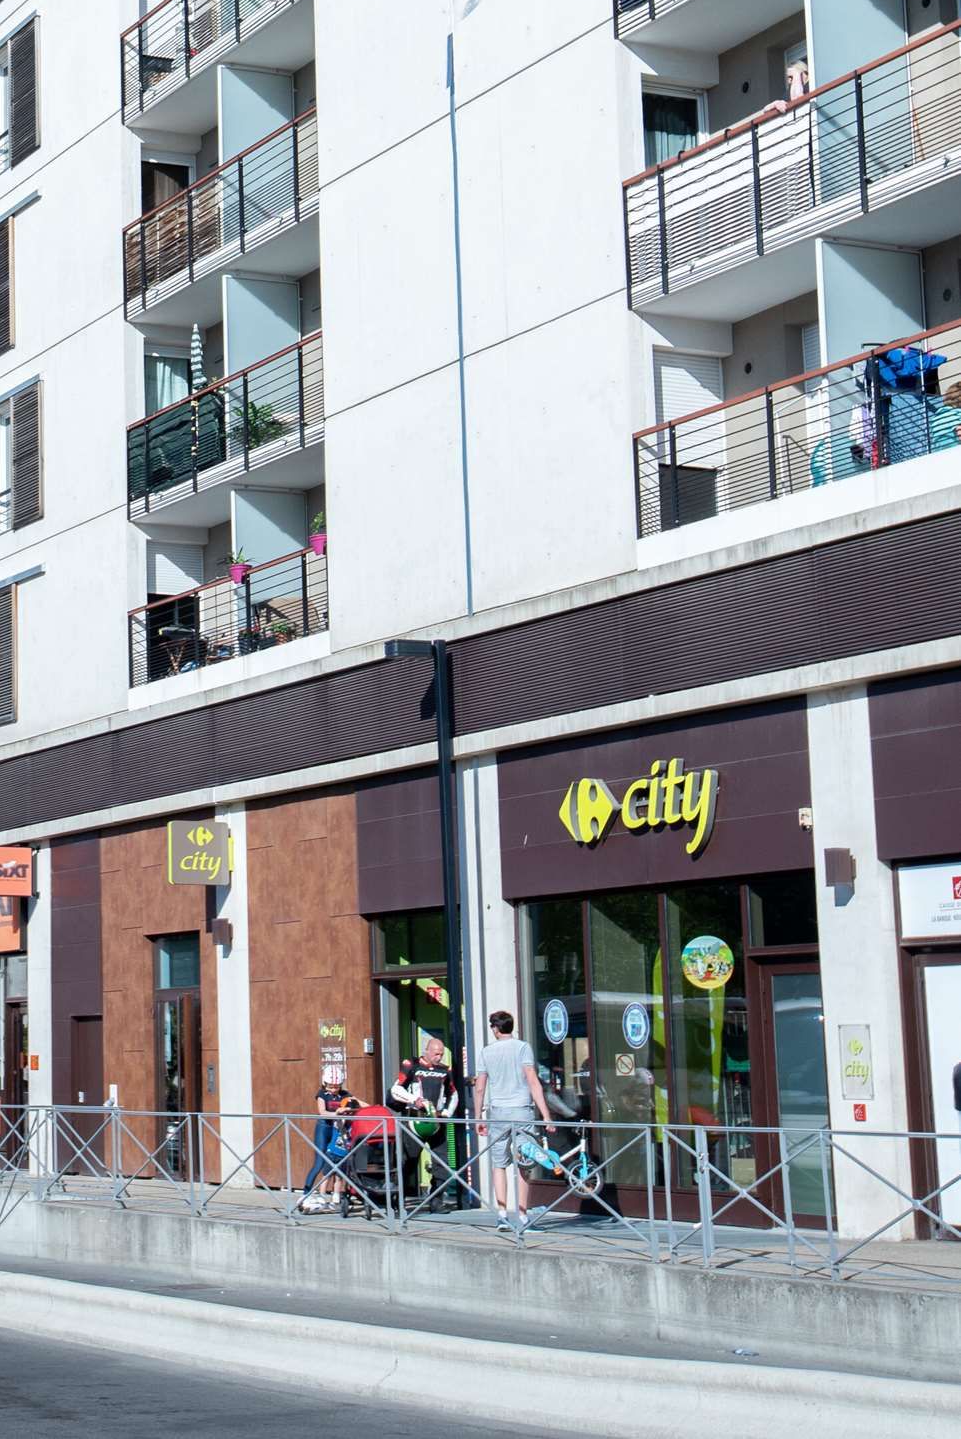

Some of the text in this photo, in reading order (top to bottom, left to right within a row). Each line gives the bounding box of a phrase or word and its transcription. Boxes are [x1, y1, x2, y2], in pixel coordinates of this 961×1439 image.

[621, 758, 718, 856] city
[180, 851, 222, 880] city
[329, 1024, 343, 1041] city
[845, 1061, 870, 1085] city
